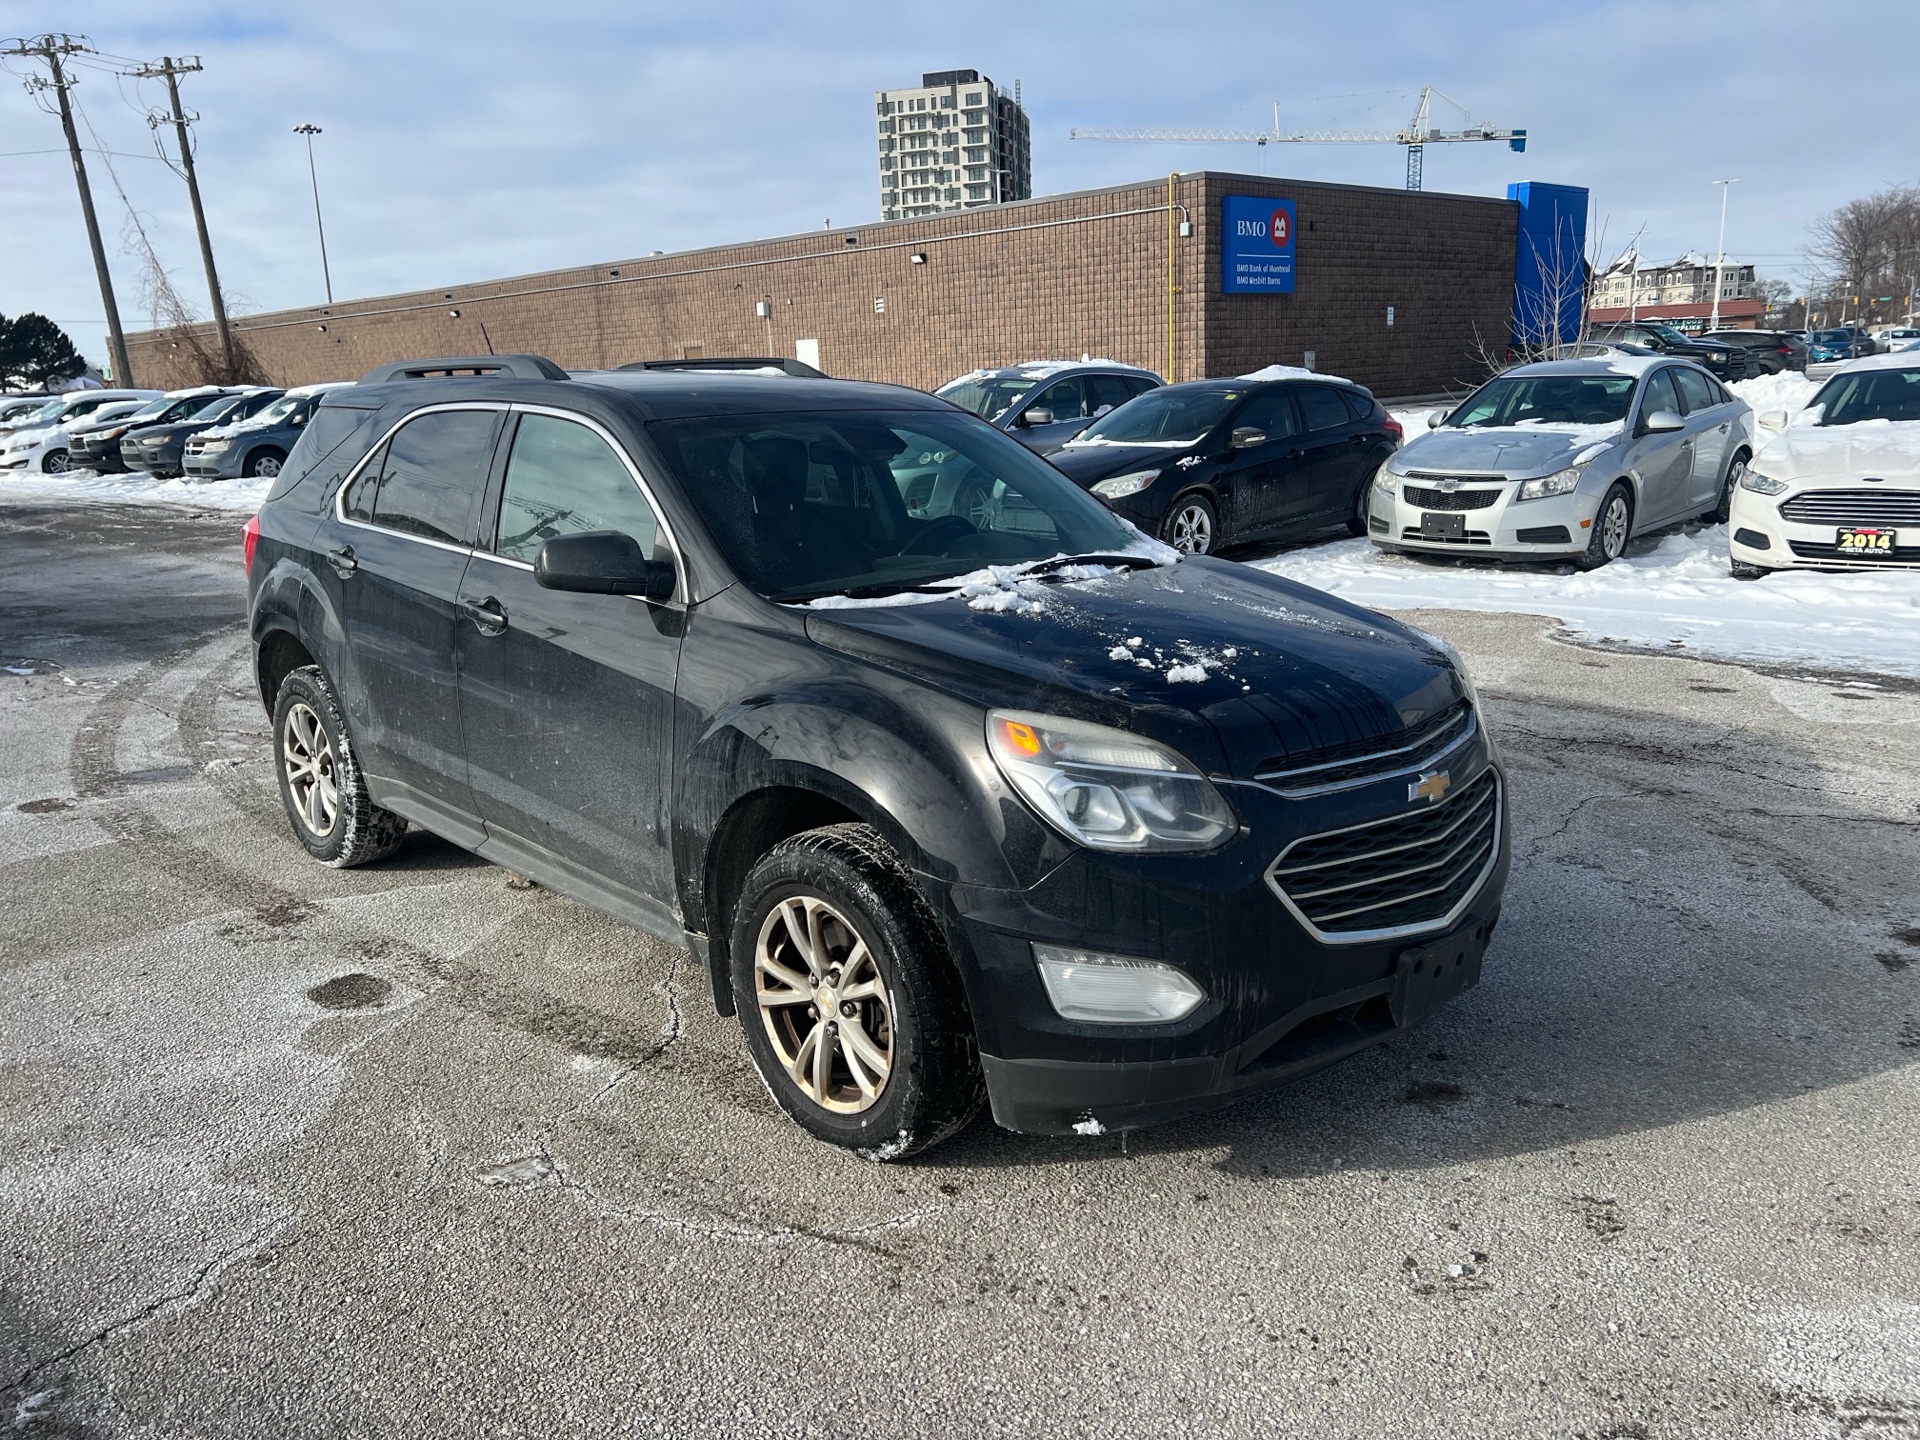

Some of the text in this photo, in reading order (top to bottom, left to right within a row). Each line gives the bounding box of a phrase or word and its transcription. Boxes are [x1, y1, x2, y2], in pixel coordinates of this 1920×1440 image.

[1237, 220, 1266, 237] BMO
[1237, 264, 1291, 273] BMO Bank of Montreal
[1237, 276, 1281, 285] BMO Nesbitt Burns
[1840, 533, 1890, 549] 2014
